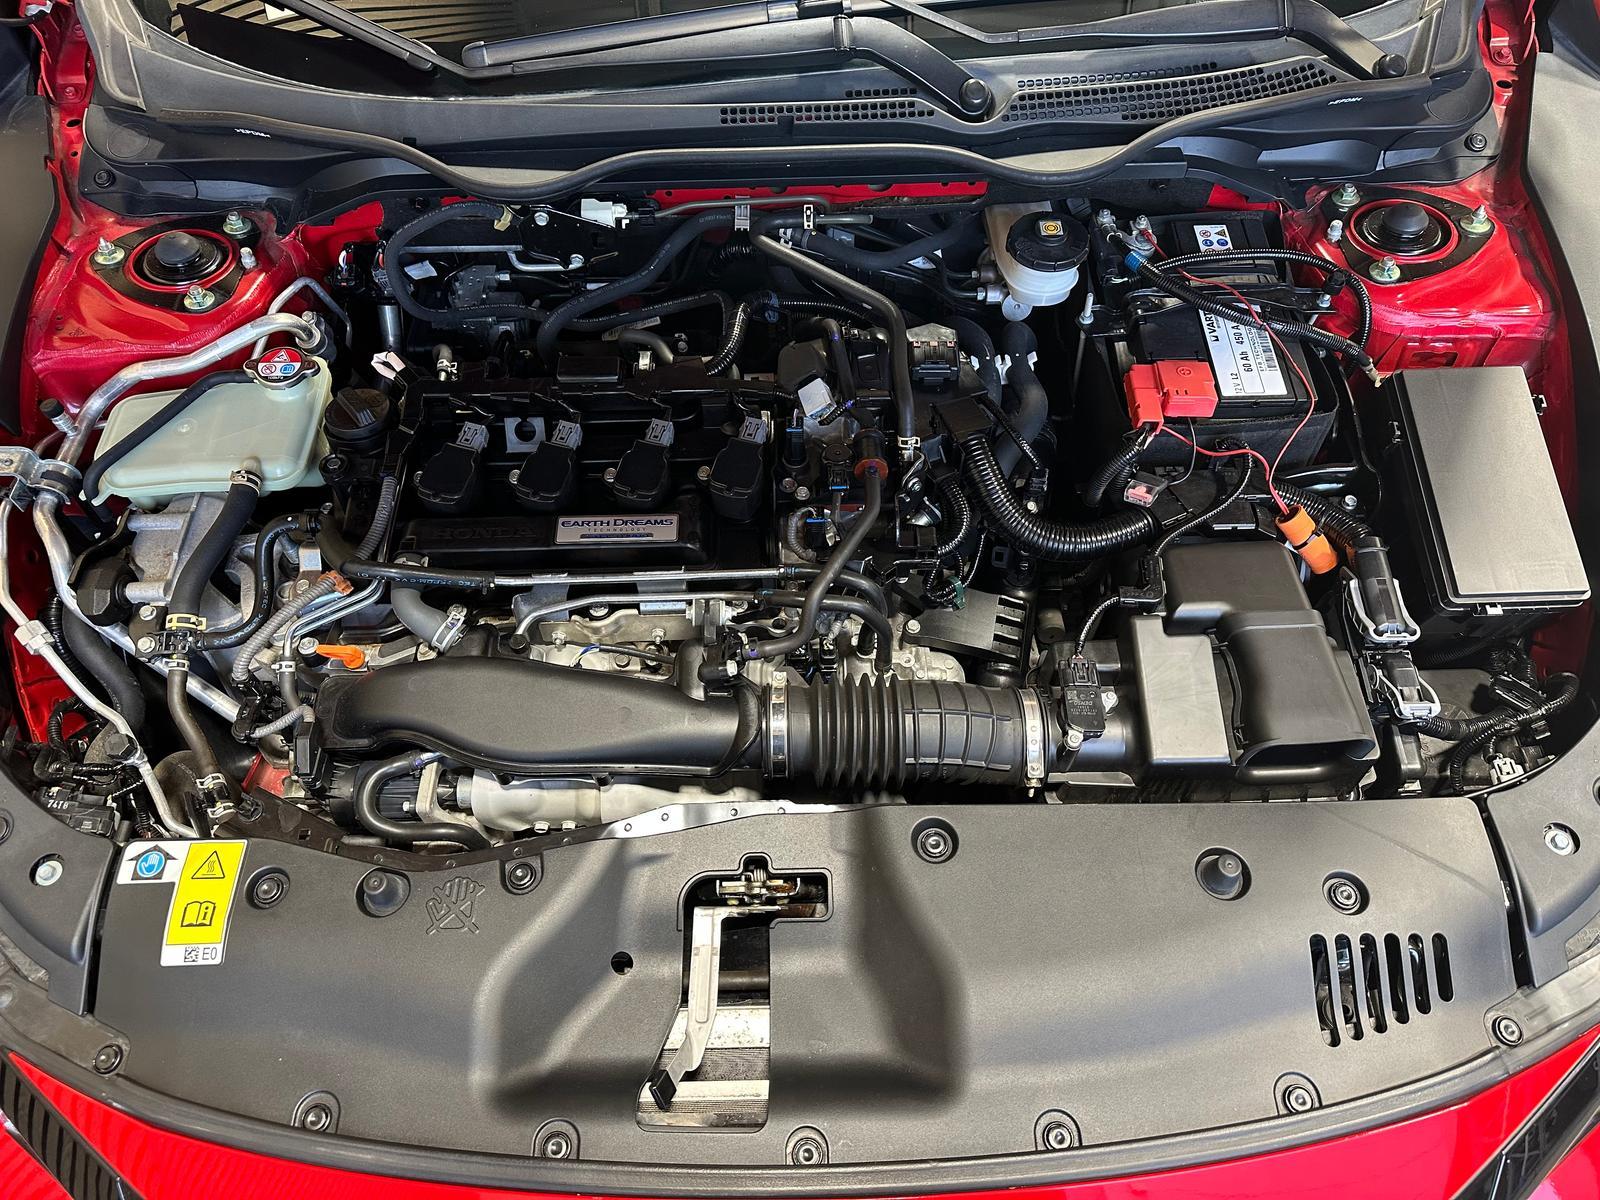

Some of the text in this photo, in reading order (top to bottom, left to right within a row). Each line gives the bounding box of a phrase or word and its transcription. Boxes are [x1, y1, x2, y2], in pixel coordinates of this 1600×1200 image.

[1234, 332, 1244, 345] 450
[1246, 326, 1261, 360] TECHNOLOG
[1239, 351, 1249, 361] Ah
[1242, 362, 1253, 373] 60
[1230, 372, 1239, 380] L2
[560, 518, 674, 528] EARTH DREAMS
